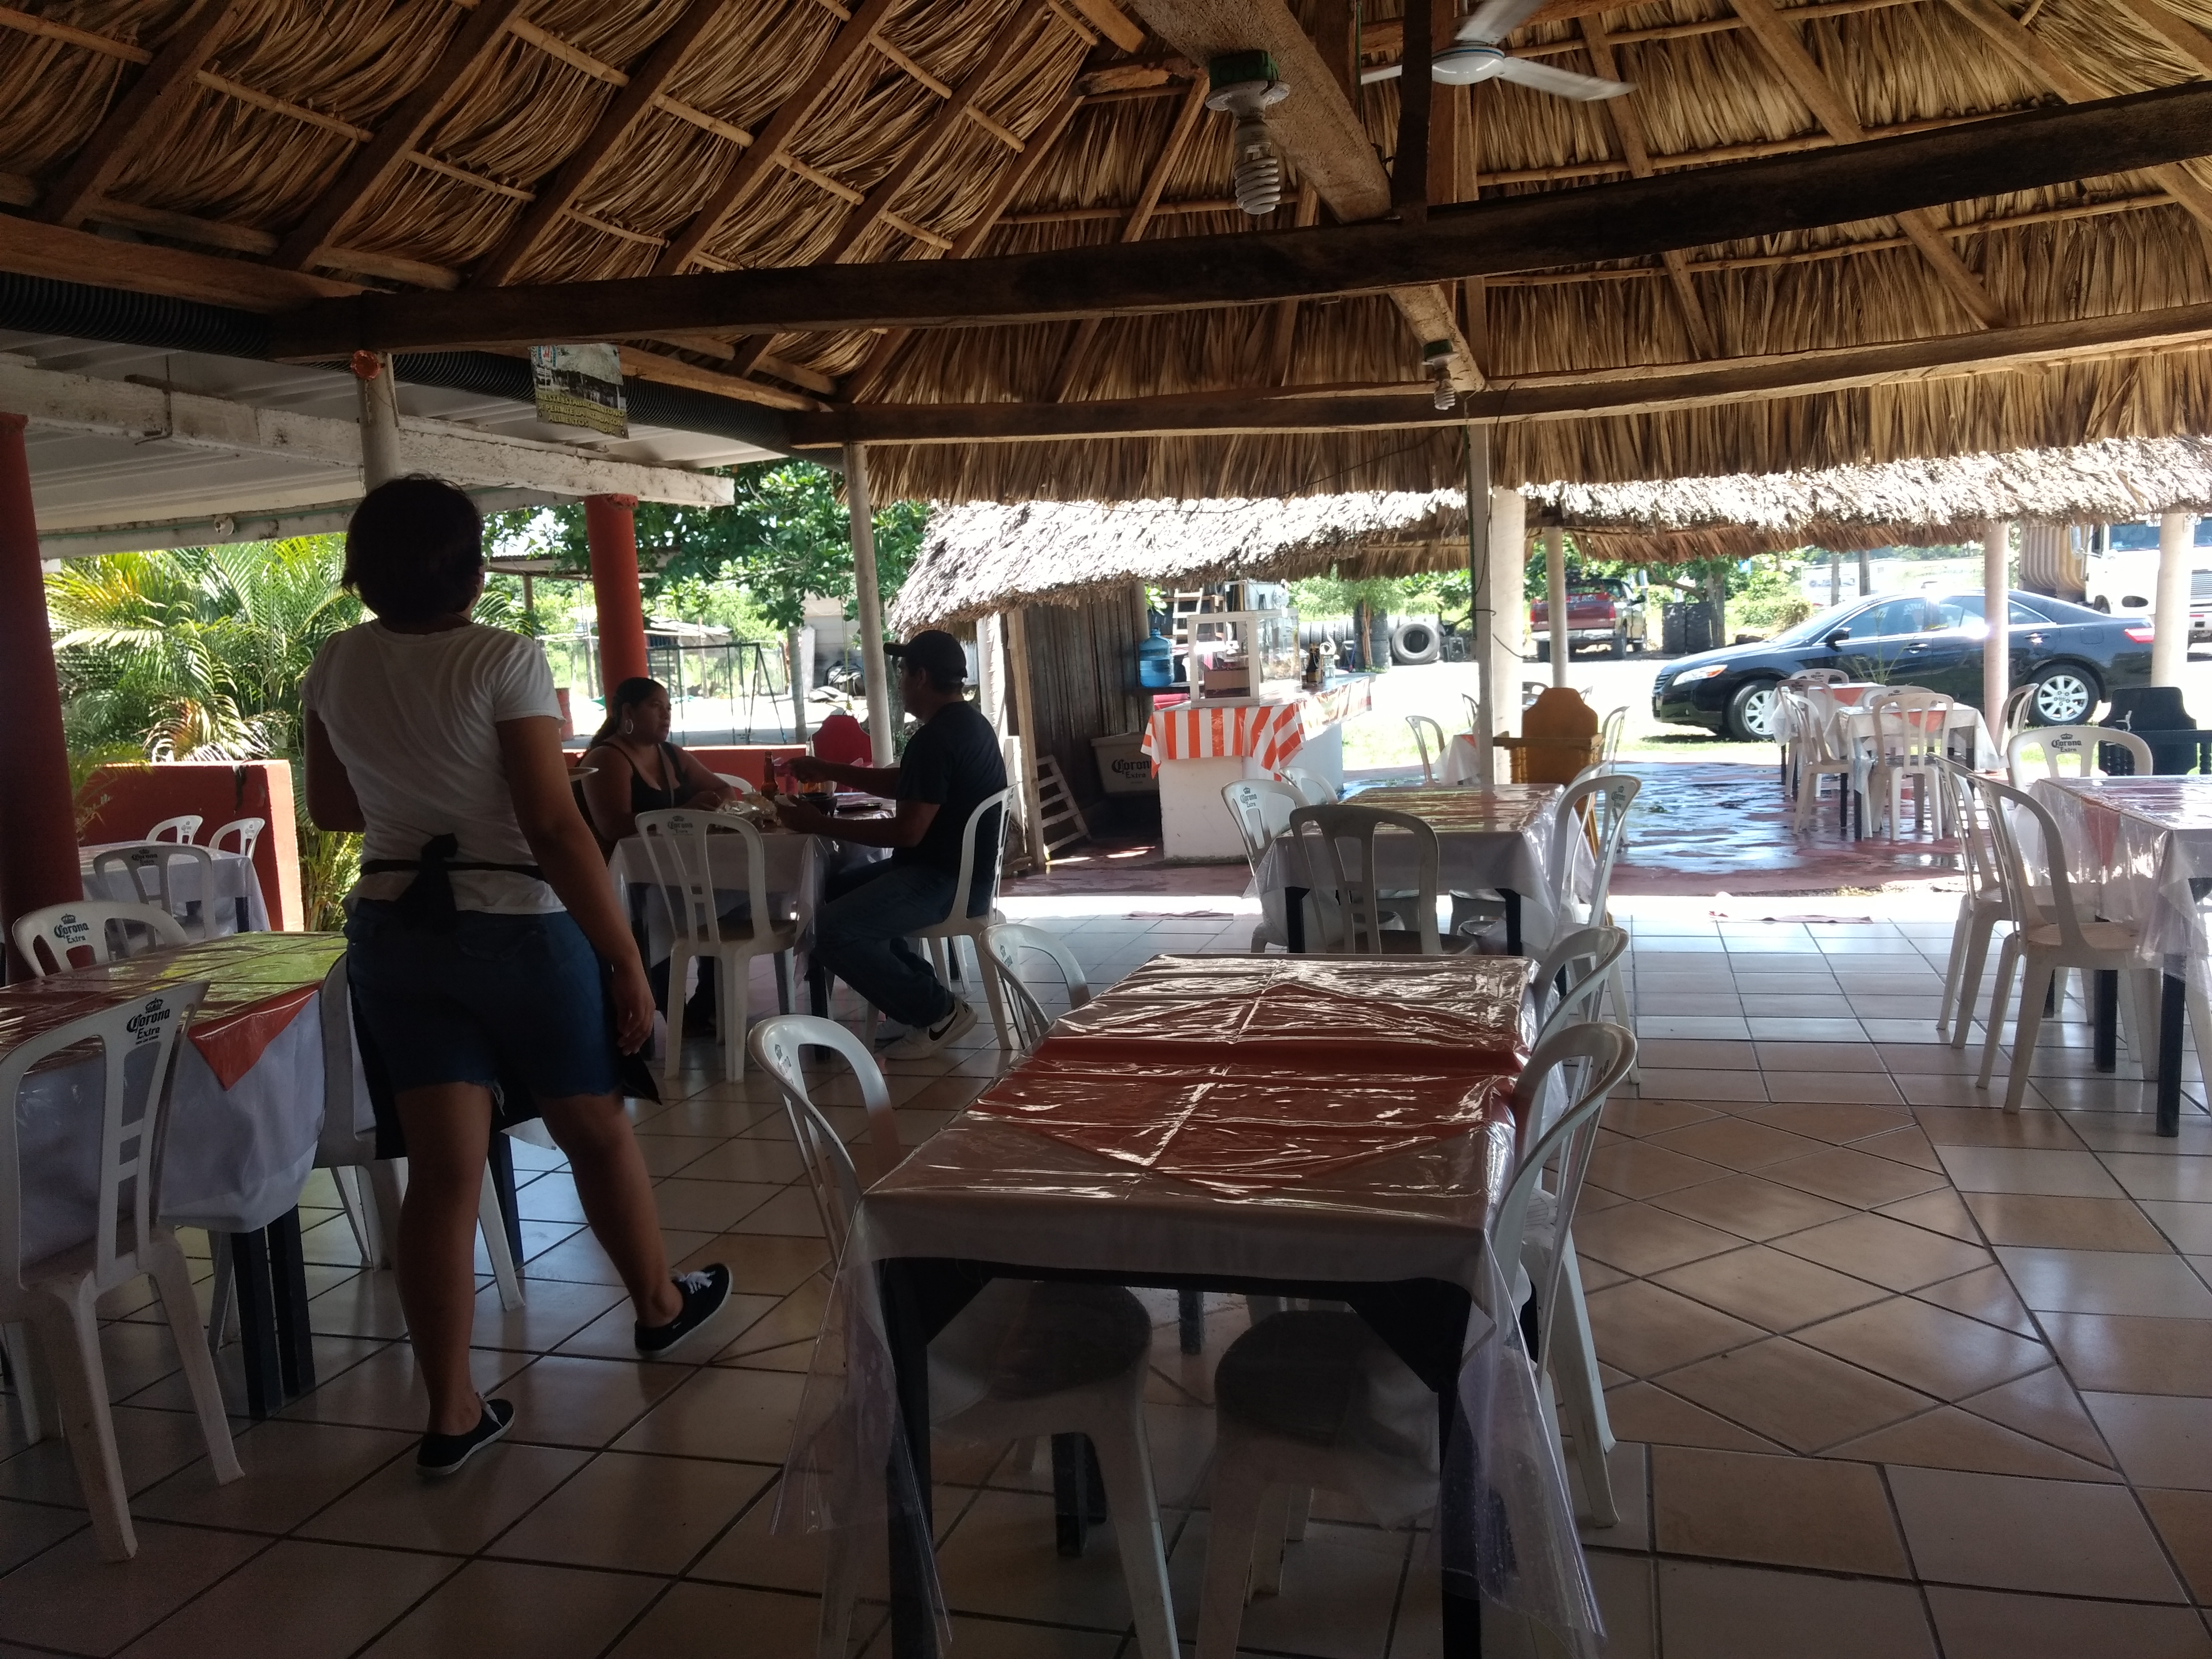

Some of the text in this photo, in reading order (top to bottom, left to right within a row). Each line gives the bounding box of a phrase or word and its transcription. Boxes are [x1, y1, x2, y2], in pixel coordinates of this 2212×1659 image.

[544, 395, 561, 403] ESTE
[613, 409, 624, 418] NO
[546, 404, 575, 416] PERMITE
[576, 409, 586, 418] LA
[610, 418, 623, 428] CON
[548, 414, 589, 428] ALIMENTOS
[2051, 739, 2082, 748] Corona
[1111, 759, 1151, 774] Coron
[1240, 793, 1258, 804] Corona
[54, 923, 90, 939] Corona
[66, 935, 86, 944] Extra
[126, 1009, 170, 1033] Corona
[137, 1027, 160, 1040] Extra
